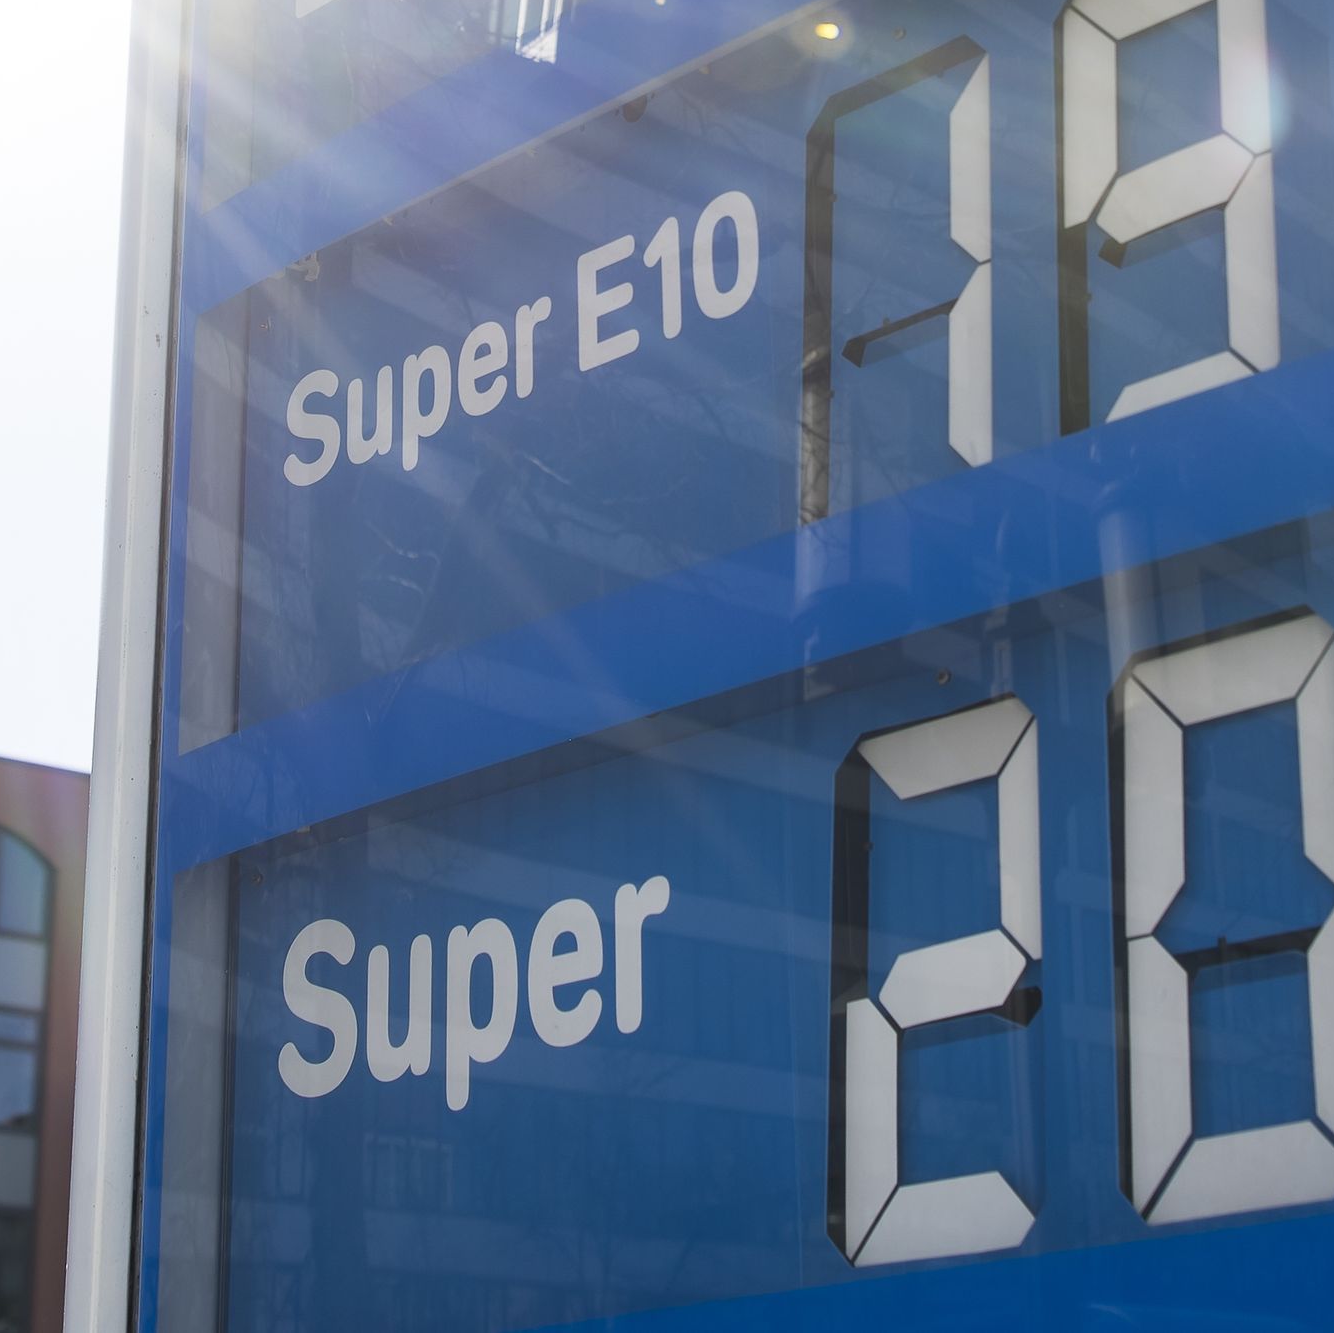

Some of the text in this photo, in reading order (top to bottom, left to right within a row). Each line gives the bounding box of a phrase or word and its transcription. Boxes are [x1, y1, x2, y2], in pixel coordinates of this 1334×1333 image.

[283, 295, 552, 487] Super
[576, 190, 760, 372] E10
[277, 874, 671, 1112] Super
